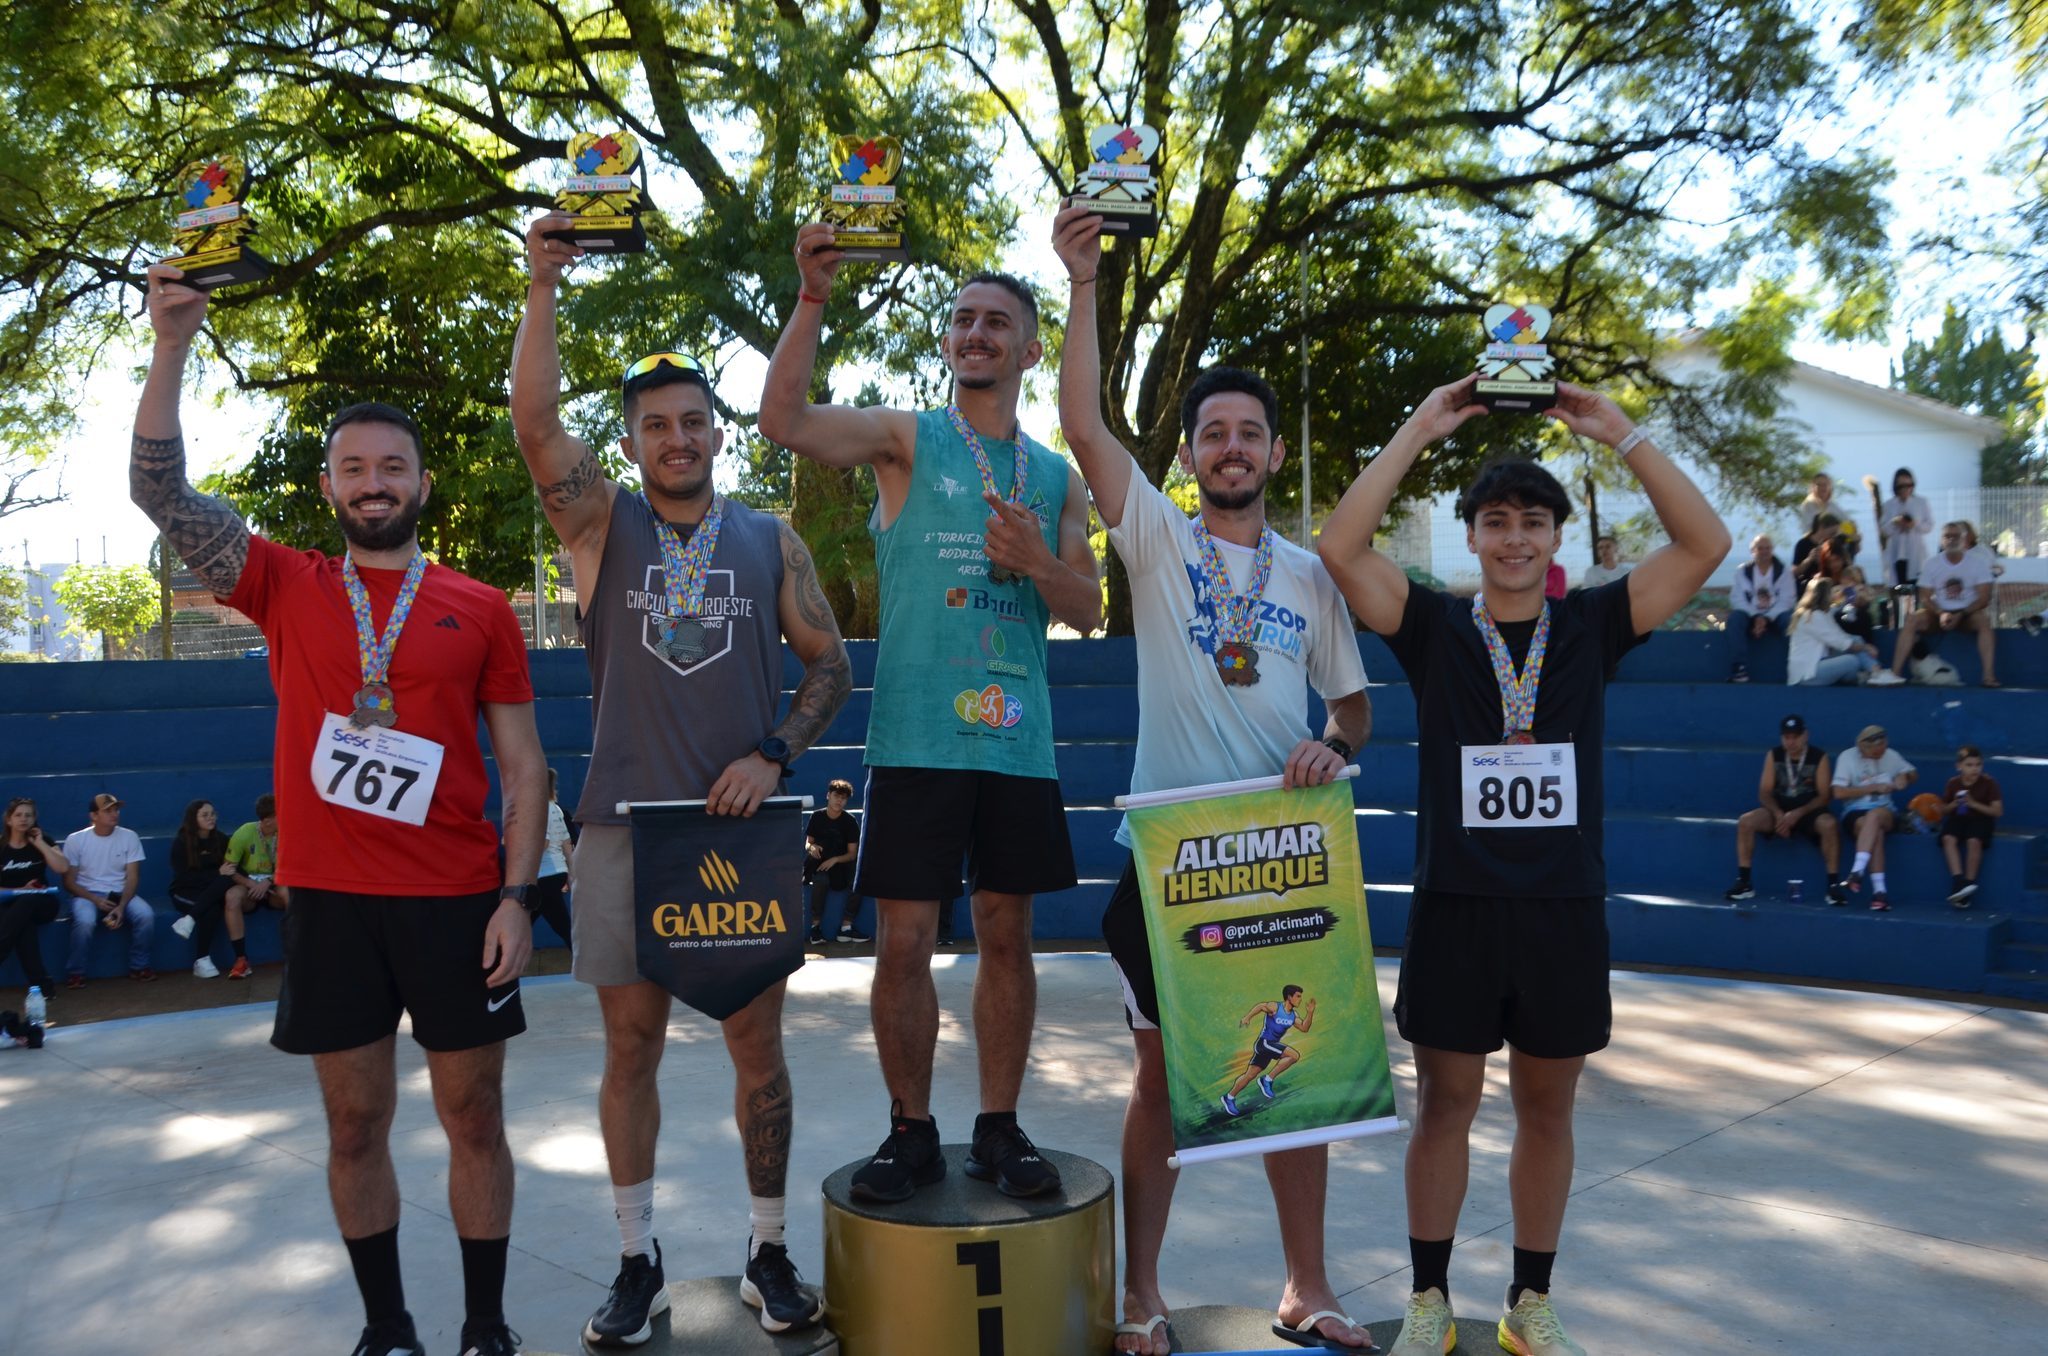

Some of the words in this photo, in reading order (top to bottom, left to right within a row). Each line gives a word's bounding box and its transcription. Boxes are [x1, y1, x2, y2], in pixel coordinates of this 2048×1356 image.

[957, 565, 988, 577] AREN
[627, 590, 666, 614] CIRCUI
[326, 749, 420, 812] 767
[1478, 775, 1563, 821] 805
[1176, 824, 1323, 872] ALCIMAR
[1168, 854, 1325, 903] HENRIQUE
[652, 900, 787, 937] GARRA
[1224, 912, 1324, 940] @prof_alcimarh
[669, 940, 699, 949] centro
[701, 939, 713, 948] de
[715, 937, 772, 948] treinamento
[1229, 938, 1271, 949] TREINADOR
[1287, 932, 1320, 941] CORRIDA
[956, 1240, 1004, 1356] 1
